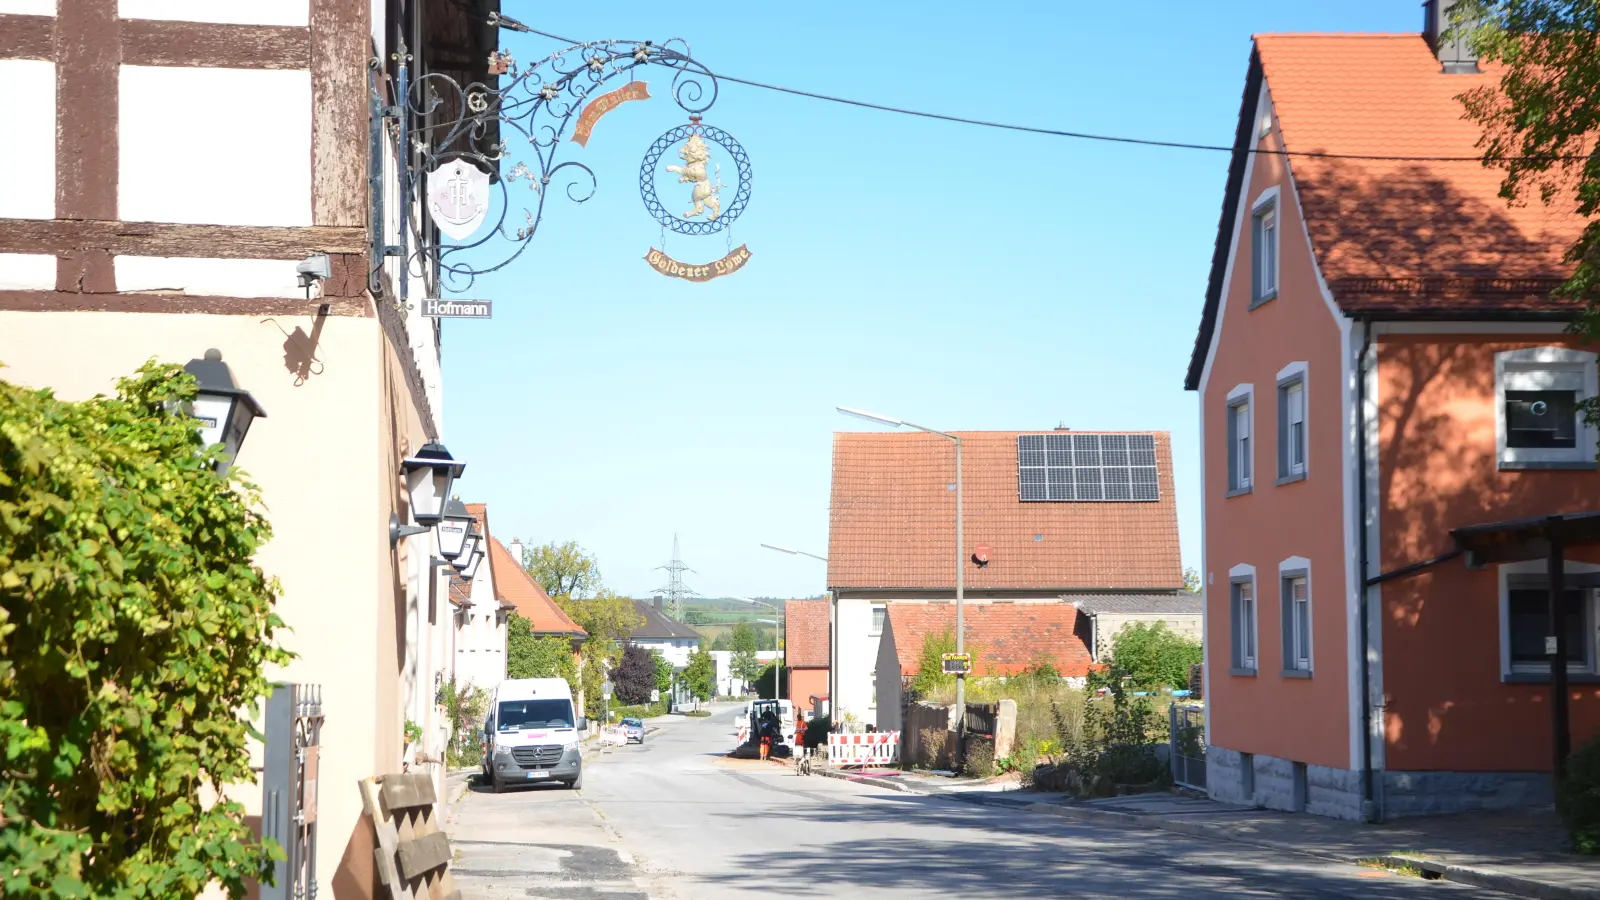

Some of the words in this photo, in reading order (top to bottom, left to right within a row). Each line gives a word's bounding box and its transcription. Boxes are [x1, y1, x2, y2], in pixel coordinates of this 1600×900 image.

[648, 250, 710, 277] Goldener
[715, 248, 749, 274] Löwe
[427, 300, 488, 316] Hofmann
